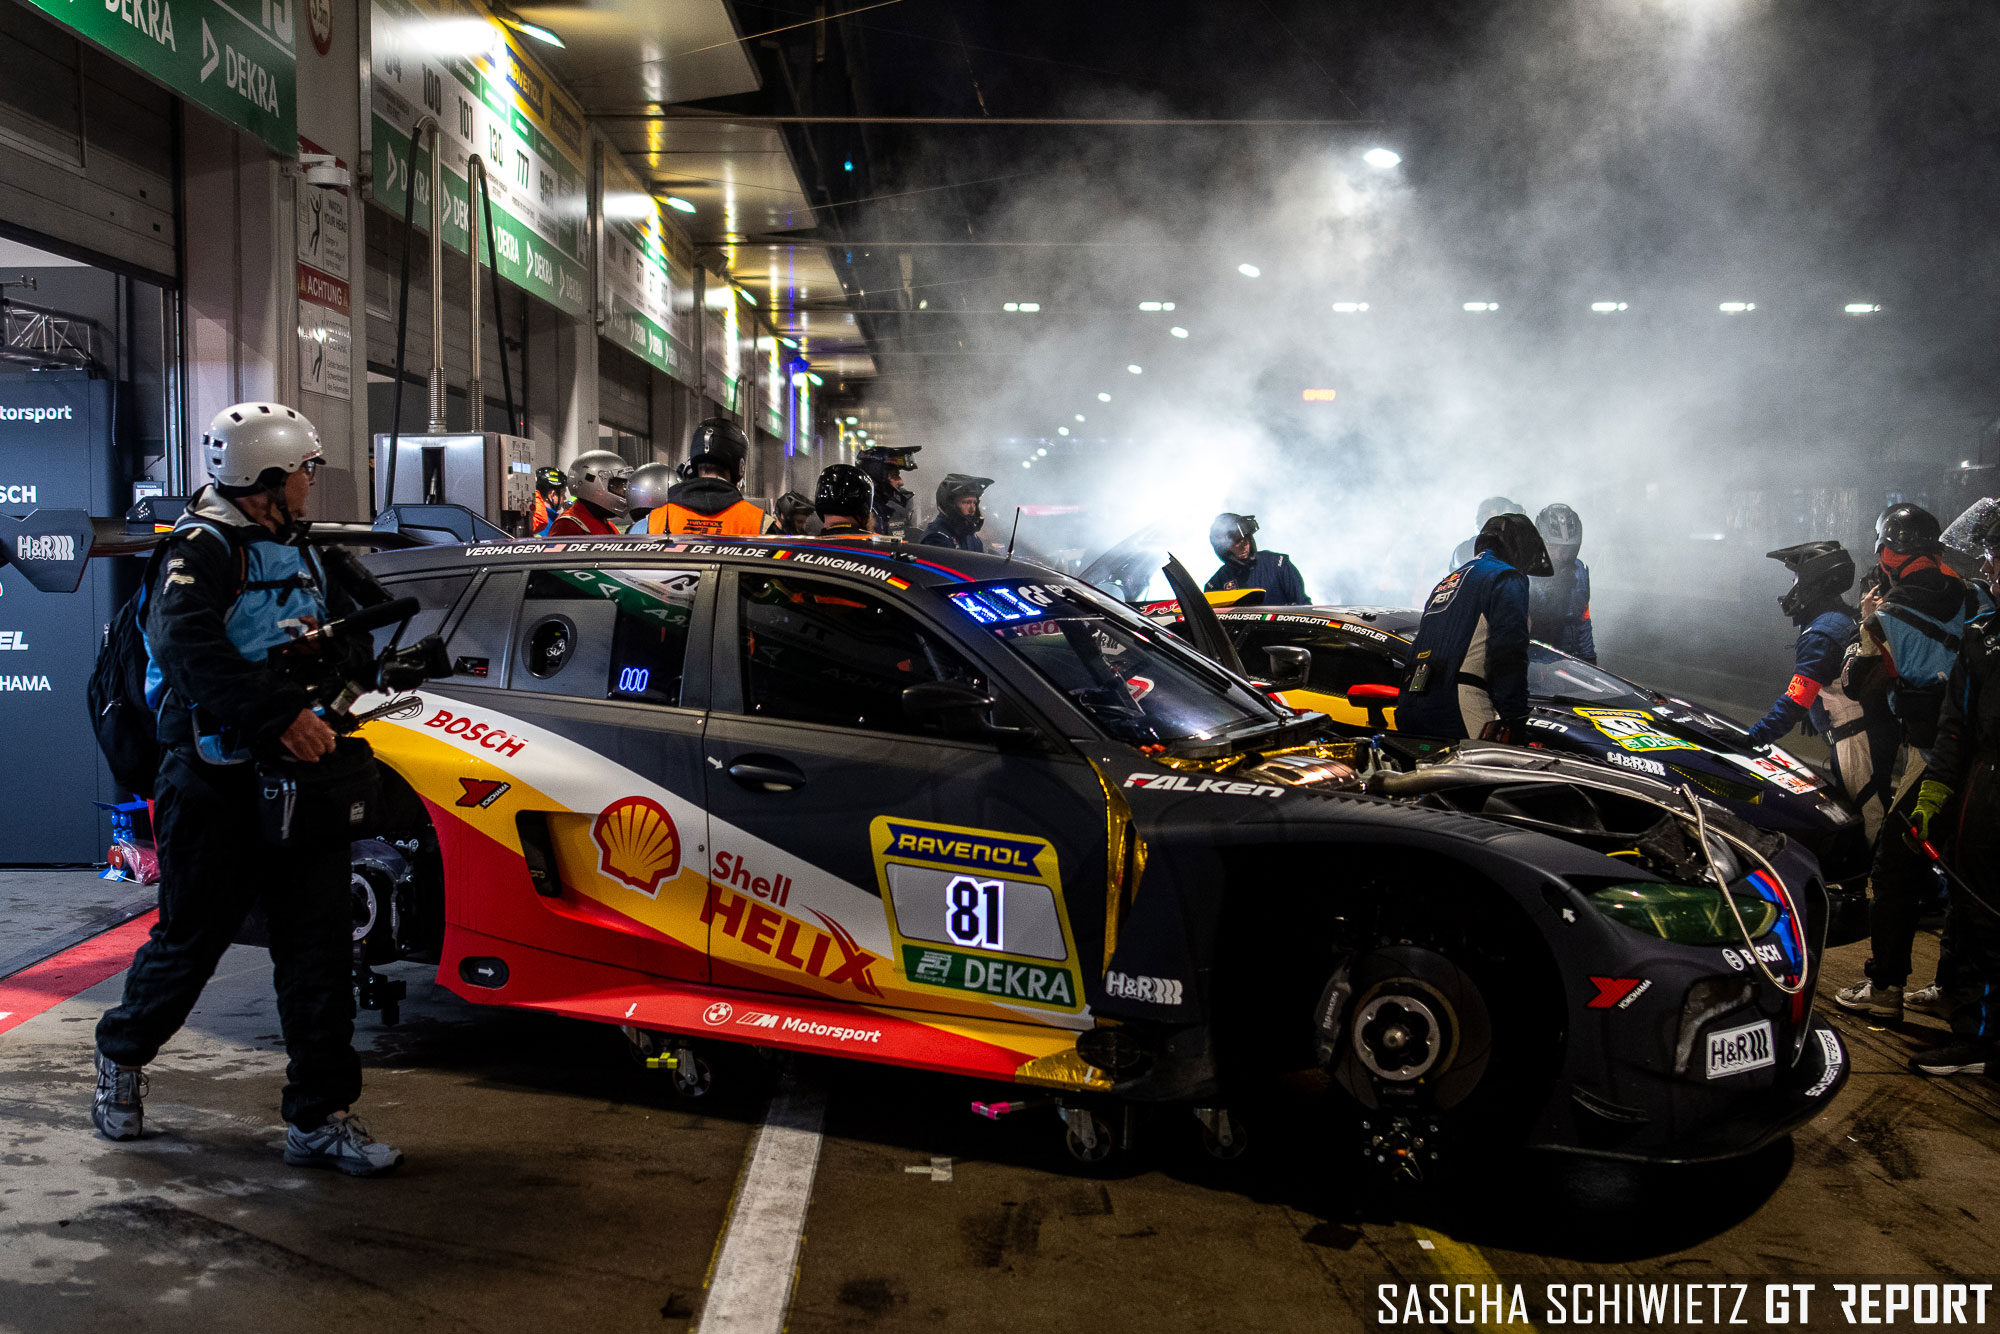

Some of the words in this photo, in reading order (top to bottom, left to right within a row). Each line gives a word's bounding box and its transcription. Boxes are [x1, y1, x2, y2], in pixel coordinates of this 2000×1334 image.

[104, 0, 177, 52] EKRA
[226, 44, 279, 118] DEKRA
[422, 62, 442, 116] 100
[458, 95, 473, 145] 101
[401, 158, 429, 206] DKRA
[516, 148, 530, 190] 777
[497, 226, 519, 266] DEKRA
[535, 252, 554, 287] DEKRA
[307, 275, 343, 306] ACHTUNG
[465, 543, 546, 557] VERHAGEN
[566, 543, 588, 553] DE
[590, 543, 665, 552] PHILLIPPI
[689, 545, 713, 554] DE
[715, 546, 768, 558] WILDE
[793, 552, 892, 581] KLINGMANN
[1276, 614, 1330, 627] BORTOLOTTI
[1341, 623, 1388, 643] ENGSTLER
[0, 675, 52, 692] HAMA
[424, 710, 529, 758] BOSCH
[481, 783, 510, 808] YOKOHAMA
[1123, 773, 1286, 797] FALKEN
[898, 834, 1028, 867] RAVENOL
[712, 850, 792, 908] Shell
[946, 876, 1004, 951] 81
[700, 881, 885, 999] HELIX
[1739, 944, 1783, 965] BSCH
[963, 957, 1071, 1004] DEKRA
[1106, 971, 1158, 1002] H&R
[1617, 979, 1652, 1010] YOKOHAMA
[781, 1016, 882, 1043] Motorsport
[1710, 1034, 1751, 1069] H&R
